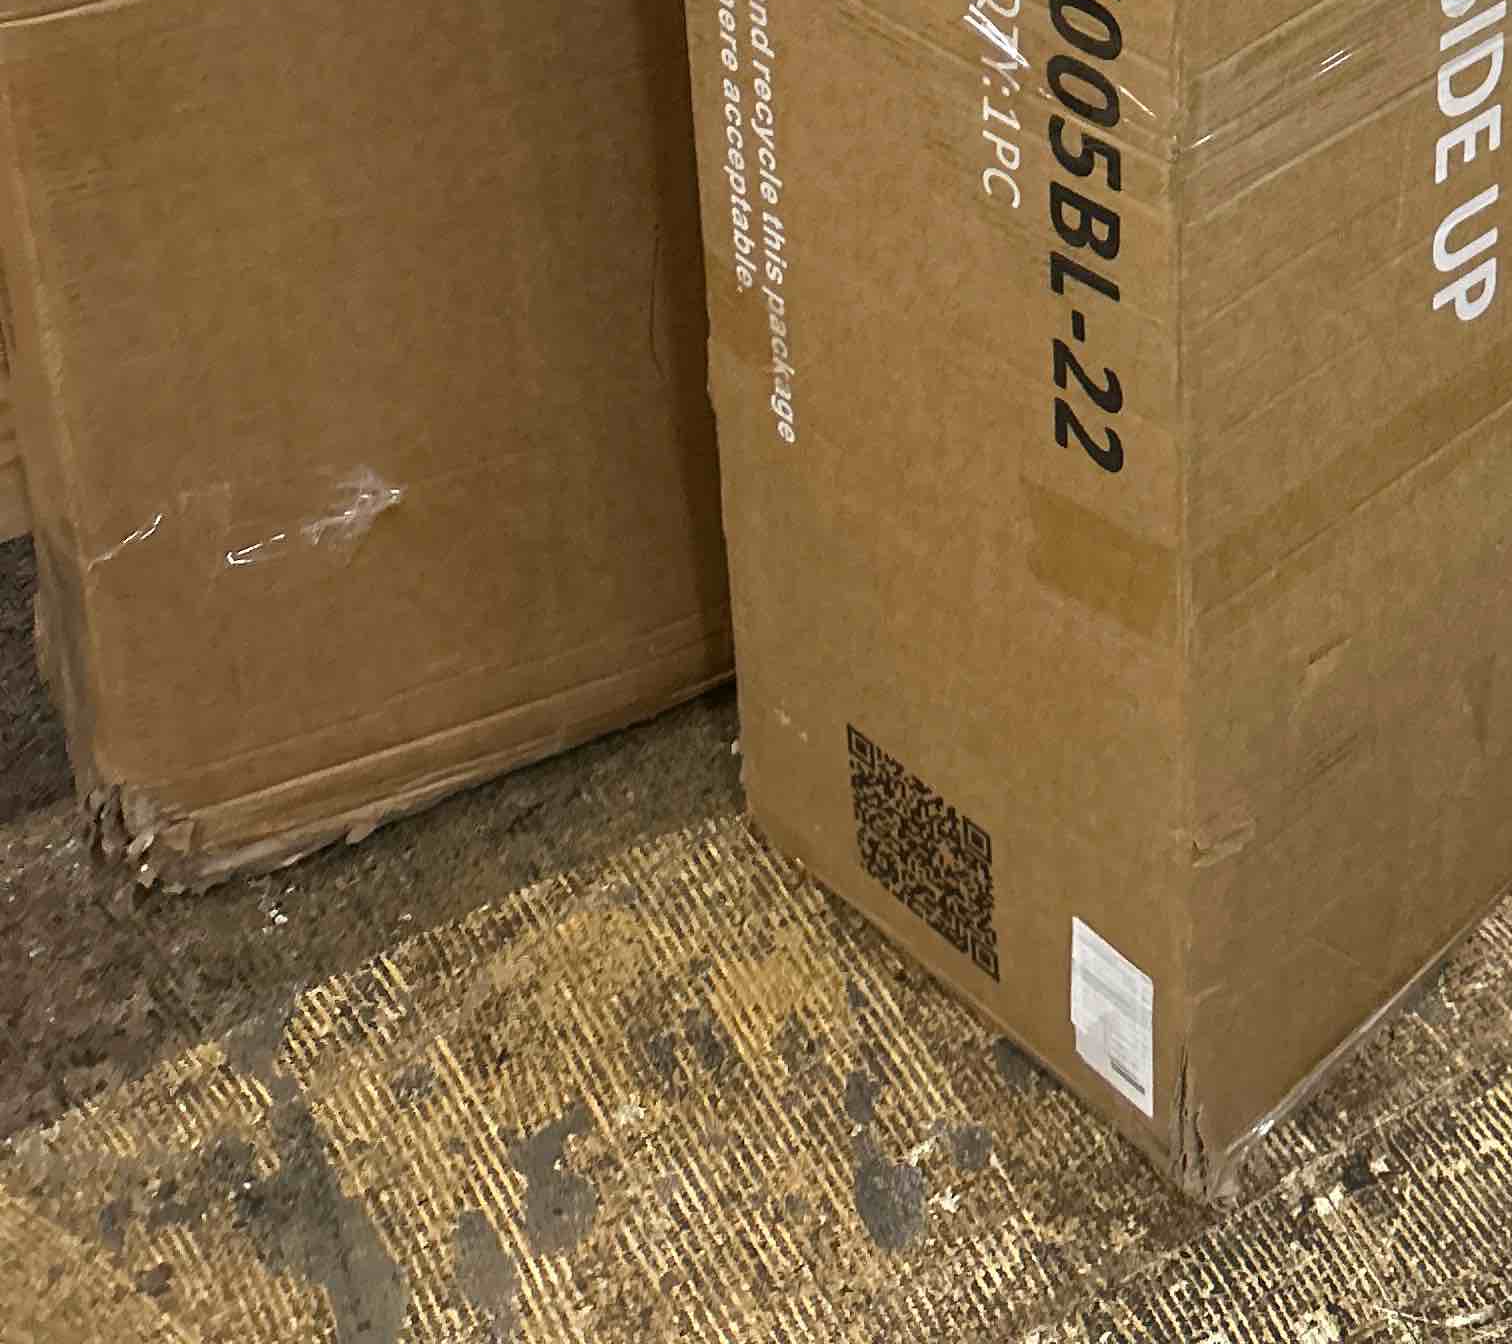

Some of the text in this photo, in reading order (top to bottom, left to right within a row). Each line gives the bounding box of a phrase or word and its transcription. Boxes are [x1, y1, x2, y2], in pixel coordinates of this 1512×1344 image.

[722, 78, 754, 295] acceptable.
[751, 57, 783, 207] recycle
[762, 212, 789, 286] this
[1430, 182, 1501, 322] UP
[760, 284, 797, 446] package
